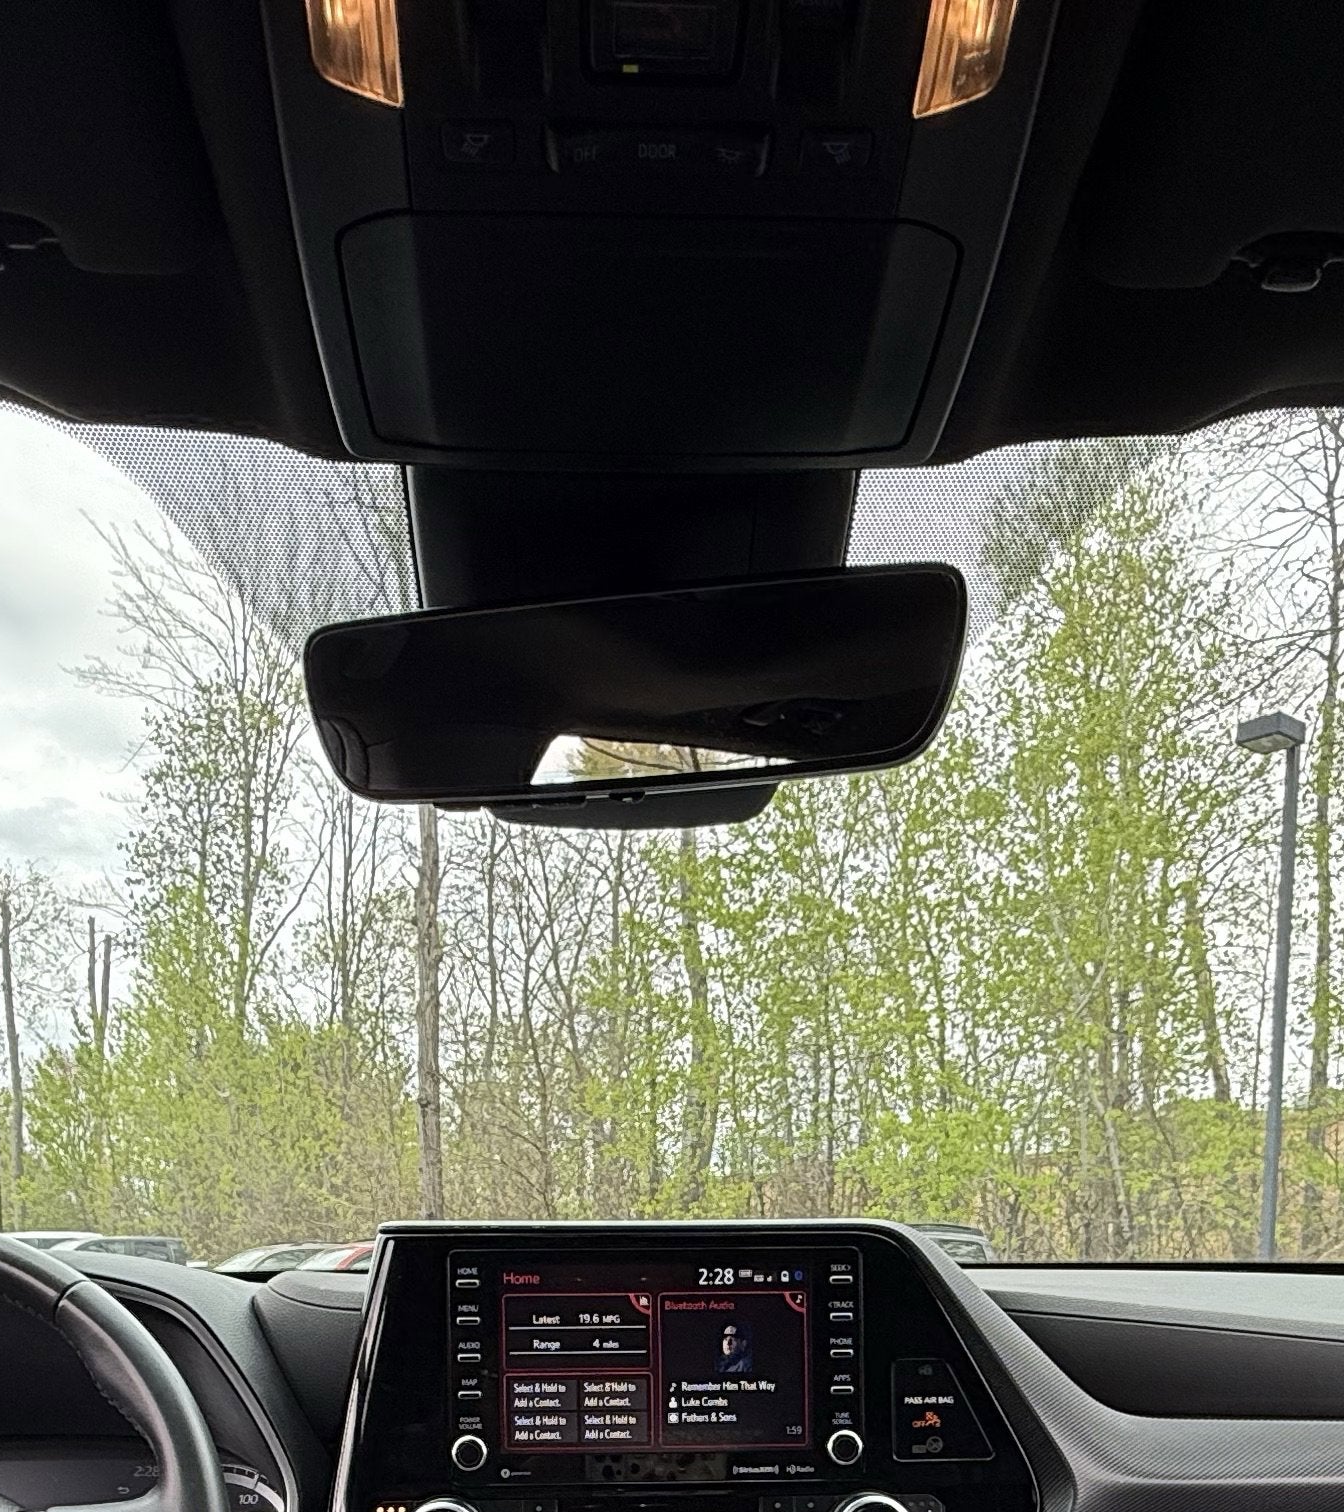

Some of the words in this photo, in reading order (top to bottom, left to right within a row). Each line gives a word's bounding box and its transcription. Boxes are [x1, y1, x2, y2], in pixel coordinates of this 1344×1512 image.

[457, 1266, 479, 1276] HOME
[503, 1271, 541, 1285] Home
[698, 1268, 736, 1286] 2:28
[458, 1304, 479, 1313] MENU
[664, 1300, 708, 1311] Bluetooth
[709, 1301, 736, 1311] Audio
[532, 1314, 561, 1325] Latest
[578, 1313, 600, 1325] 19.6
[602, 1314, 622, 1325] MPG
[458, 1341, 481, 1350] AUDIO
[533, 1339, 561, 1352] Range
[592, 1339, 601, 1349] 4
[830, 1337, 853, 1346] PHONE
[513, 1383, 534, 1394] Select
[541, 1383, 557, 1394] Hold
[558, 1383, 566, 1394] to
[583, 1382, 604, 1393] Select
[611, 1382, 627, 1393] Hold
[628, 1382, 636, 1393] to
[681, 1381, 722, 1392] Remember
[722, 1381, 739, 1391] Him
[740, 1380, 758, 1391] That
[758, 1380, 776, 1393] Way
[514, 1397, 528, 1408] Add
[584, 1396, 598, 1407] Add
[681, 1397, 701, 1407] Luke
[701, 1396, 729, 1407] Combs
[904, 1396, 923, 1405] PASS
[923, 1396, 937, 1405] AIR
[938, 1396, 955, 1405] BAG
[514, 1416, 535, 1427] Select
[542, 1416, 558, 1427] Hold
[559, 1416, 567, 1427] to
[584, 1415, 605, 1426] Select
[612, 1415, 628, 1426] Hold
[629, 1415, 637, 1426] to
[681, 1412, 710, 1423] Fathers
[710, 1412, 718, 1422] &
[718, 1412, 738, 1422] Sons
[515, 1430, 529, 1441] Add
[585, 1429, 599, 1440] Add
[239, 1494, 259, 1505] 100
